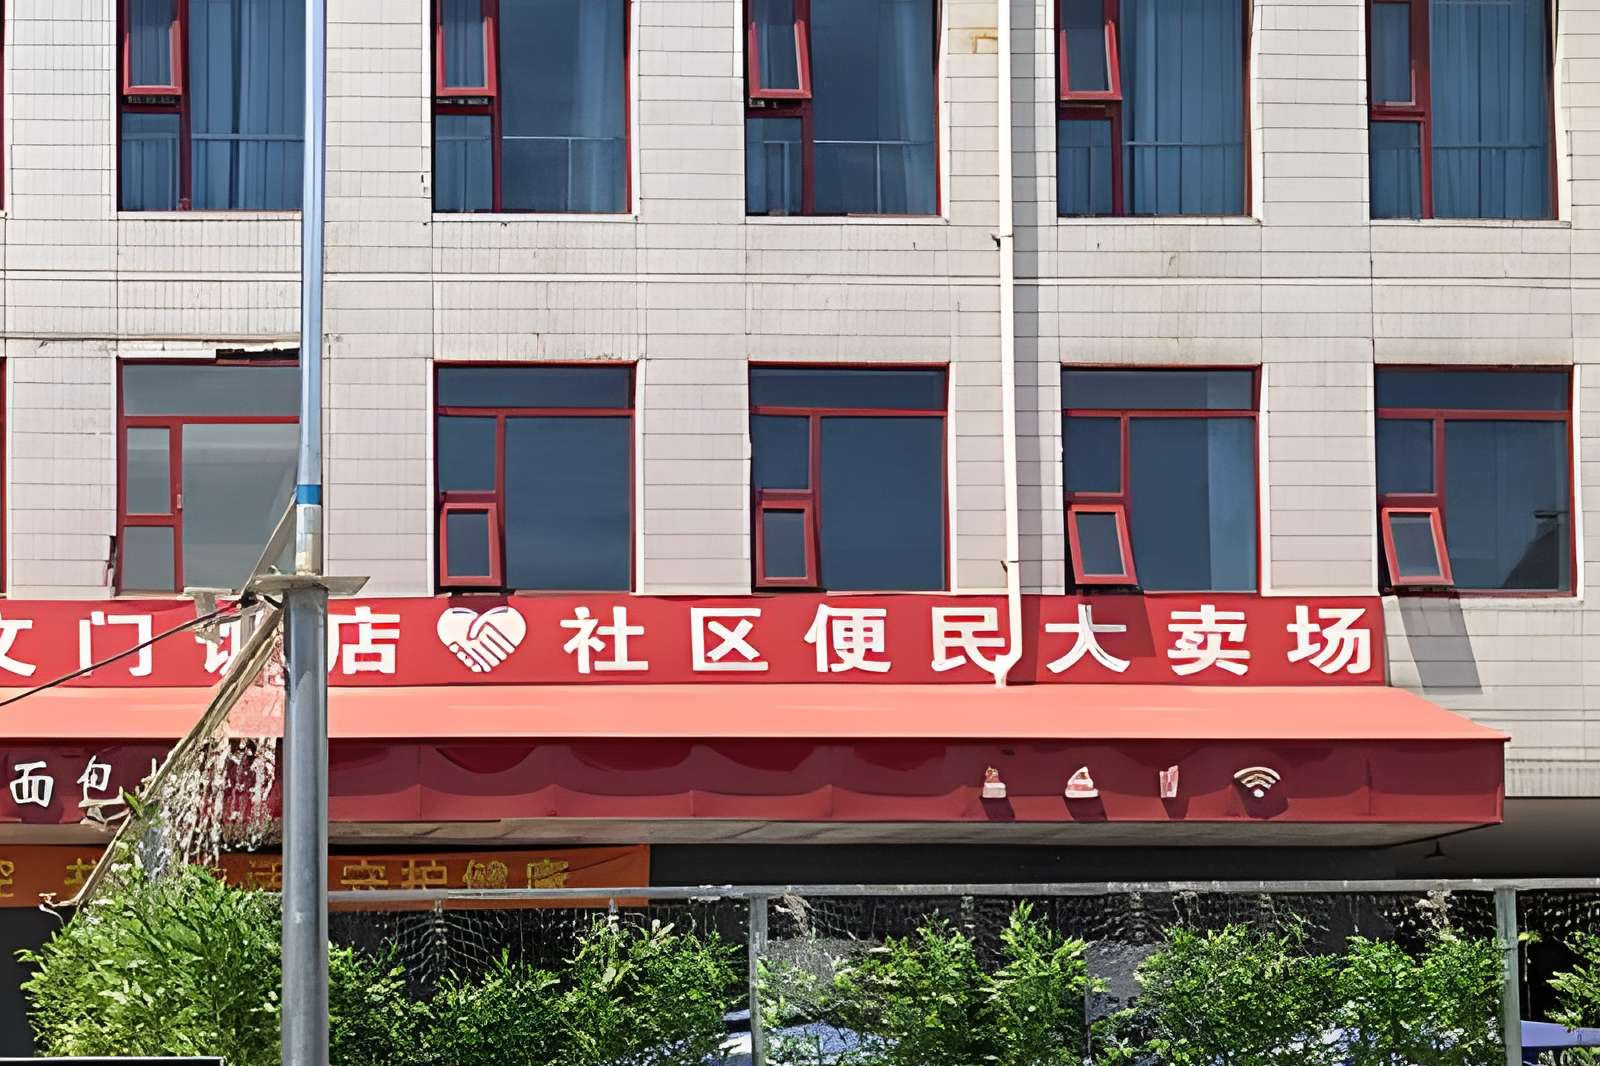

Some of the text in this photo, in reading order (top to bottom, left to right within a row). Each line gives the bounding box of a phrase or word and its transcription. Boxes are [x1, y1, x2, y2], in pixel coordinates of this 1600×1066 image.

[561, 602, 1373, 677] 社区便民大卖场
[9, 755, 157, 811] 面包
